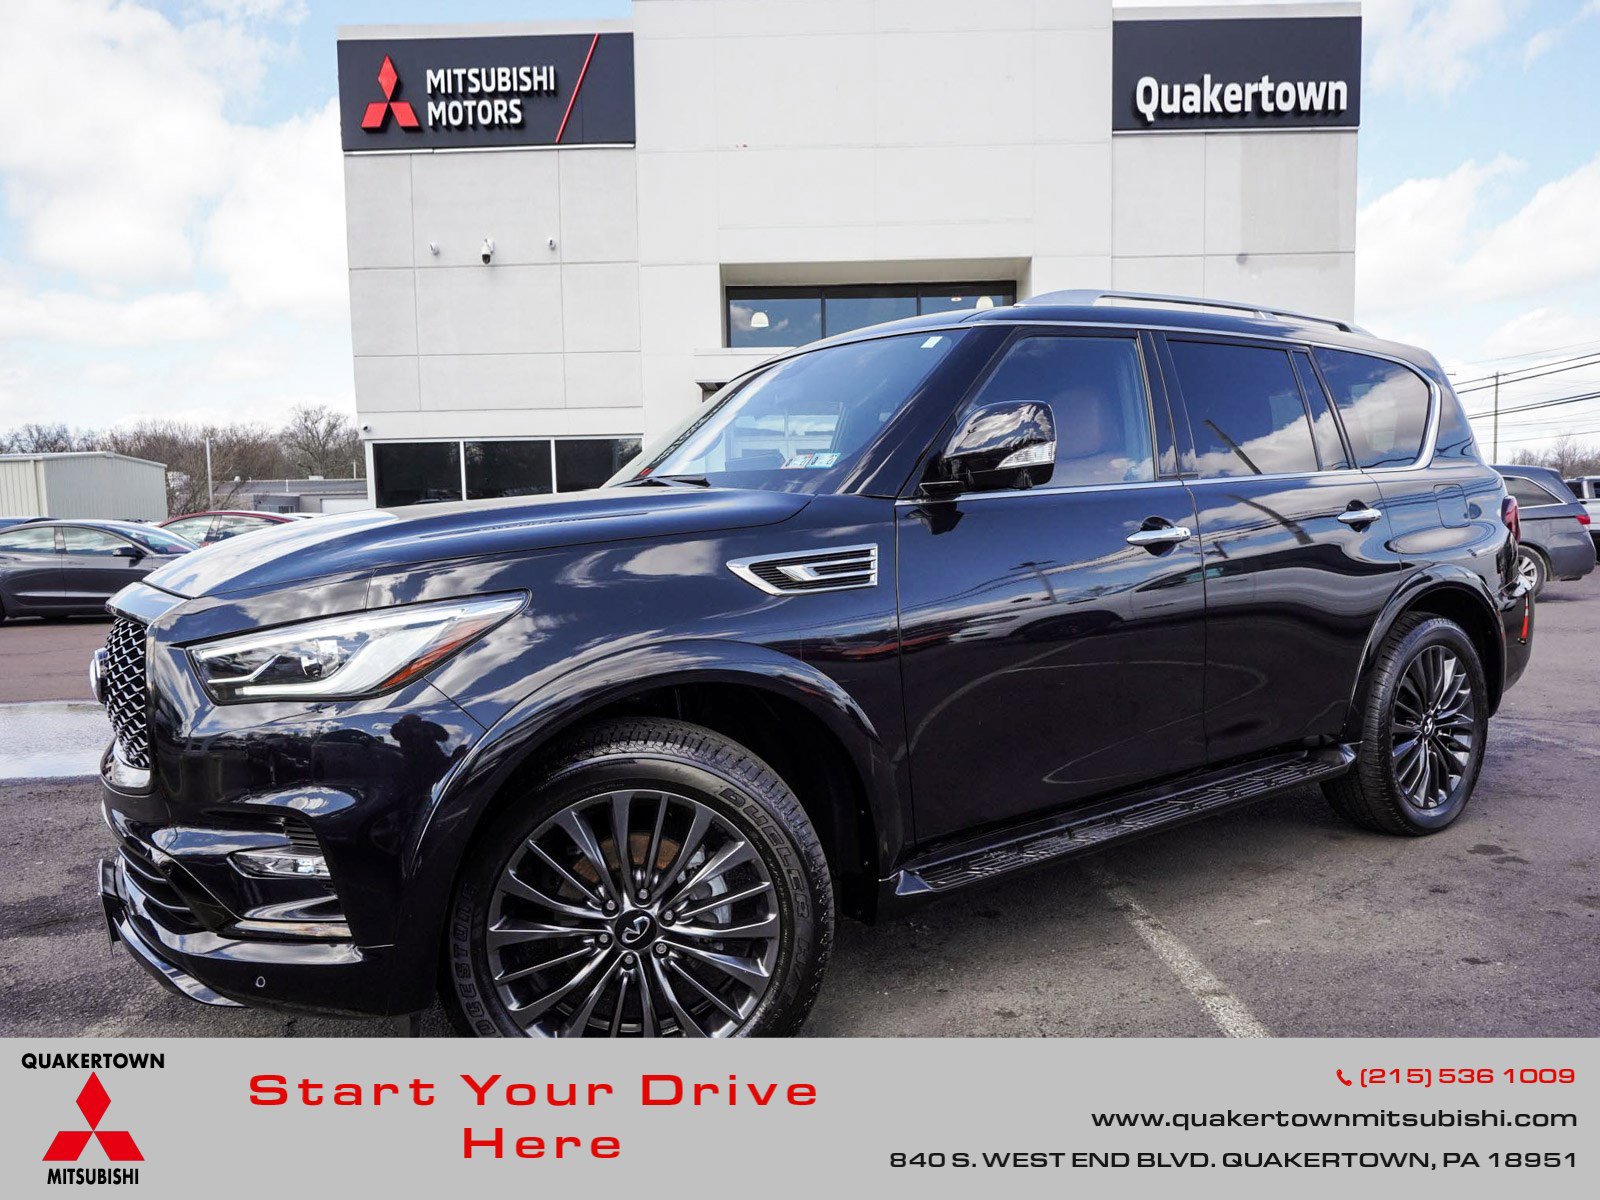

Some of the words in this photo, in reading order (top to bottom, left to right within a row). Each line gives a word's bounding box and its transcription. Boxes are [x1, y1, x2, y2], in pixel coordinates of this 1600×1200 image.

[426, 65, 556, 94] MITSUBISHI
[1135, 73, 1348, 122] Quakertown
[427, 98, 523, 126] MOTORS
[719, 787, 810, 919] DUELER
